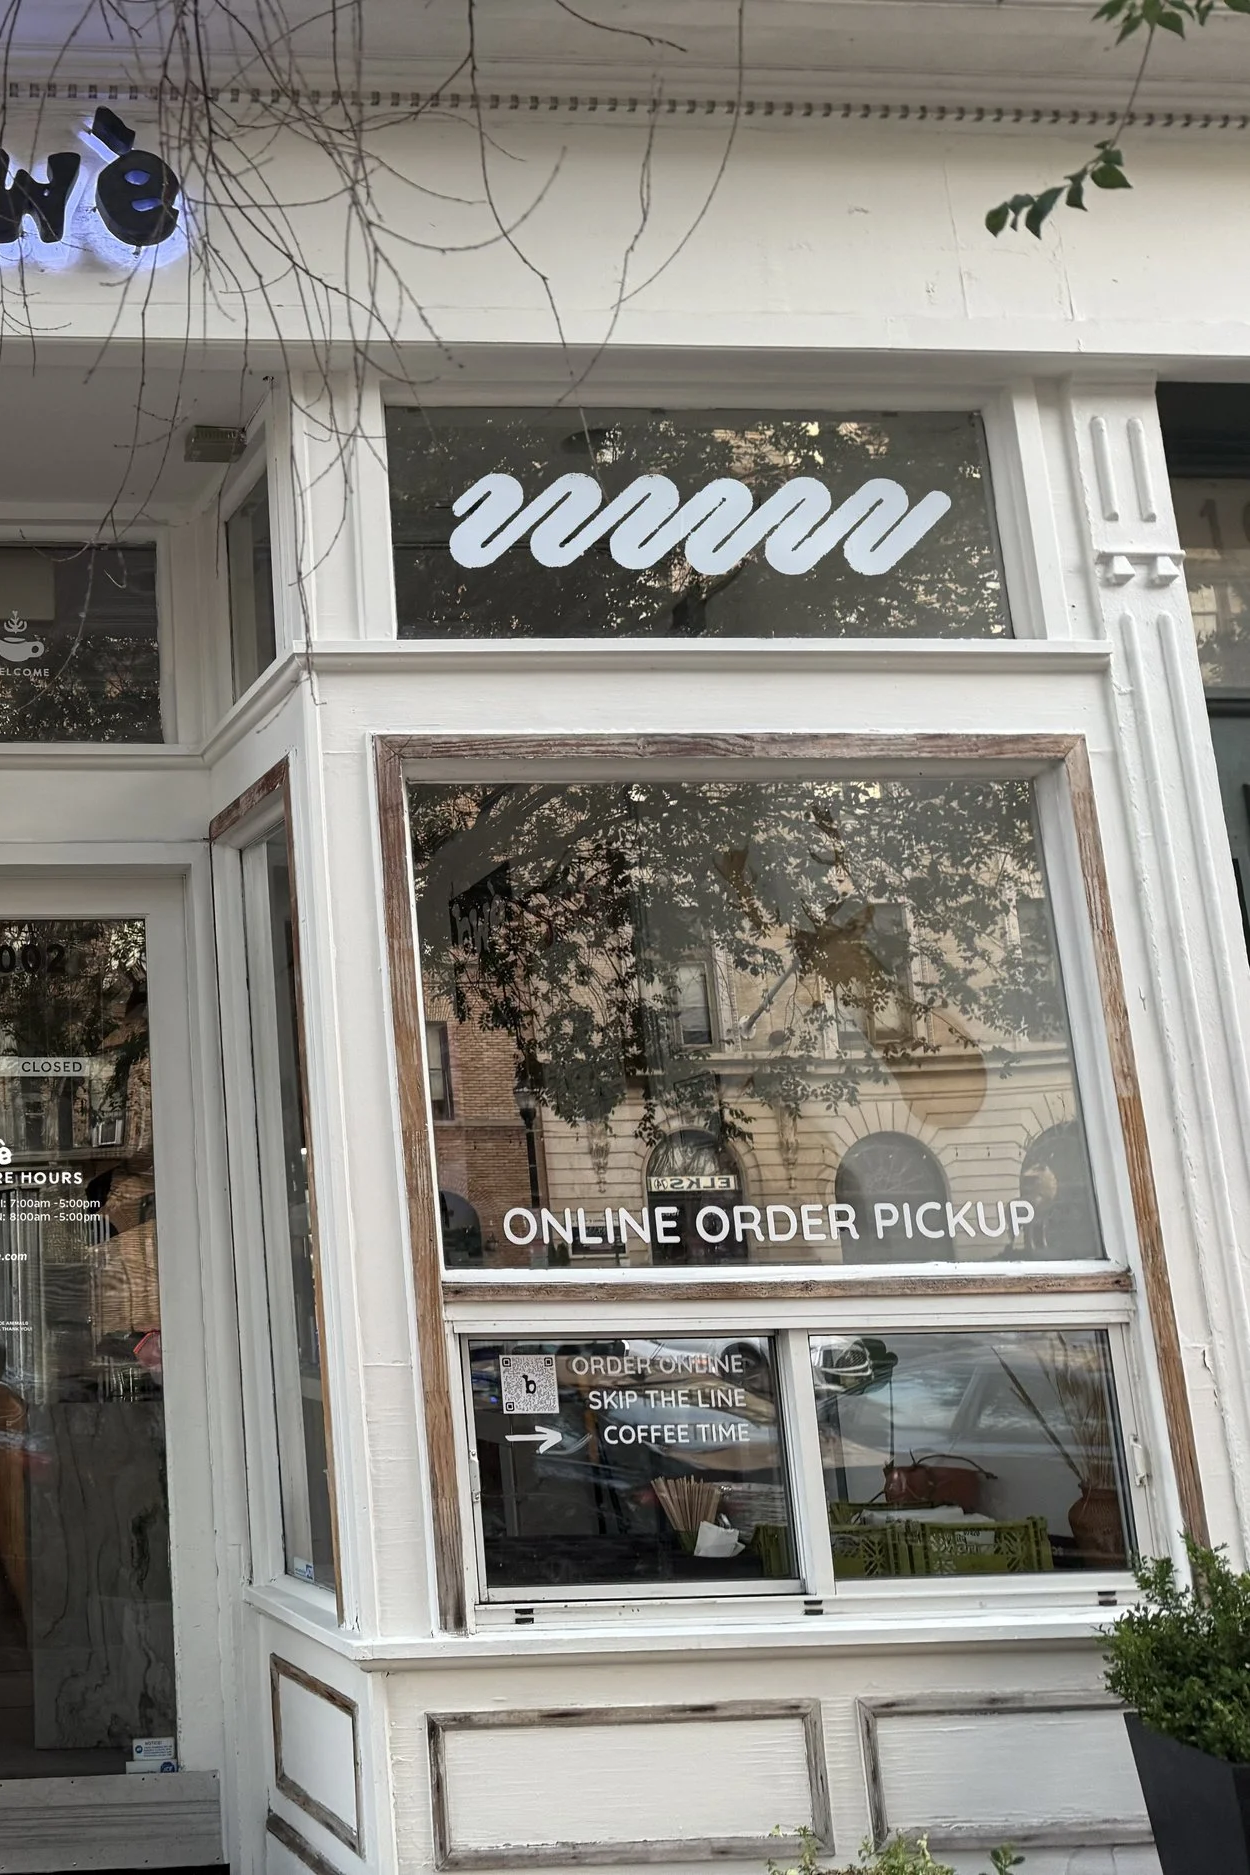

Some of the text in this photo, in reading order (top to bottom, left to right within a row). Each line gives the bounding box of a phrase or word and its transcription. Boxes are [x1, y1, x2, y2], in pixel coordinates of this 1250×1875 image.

[21, 1061, 83, 1073] CLOSED
[21, 1172, 83, 1184] HOURS
[9, 1199, 50, 1208] 7:00am
[9, 1212, 50, 1221] 8:00am
[503, 1200, 1035, 1246] ONLINE ORDER PICKUP
[572, 1353, 744, 1375] ORDER ONLINE
[588, 1388, 747, 1411] SKIP THE LINE
[603, 1423, 751, 1445] COFFEE TIME
